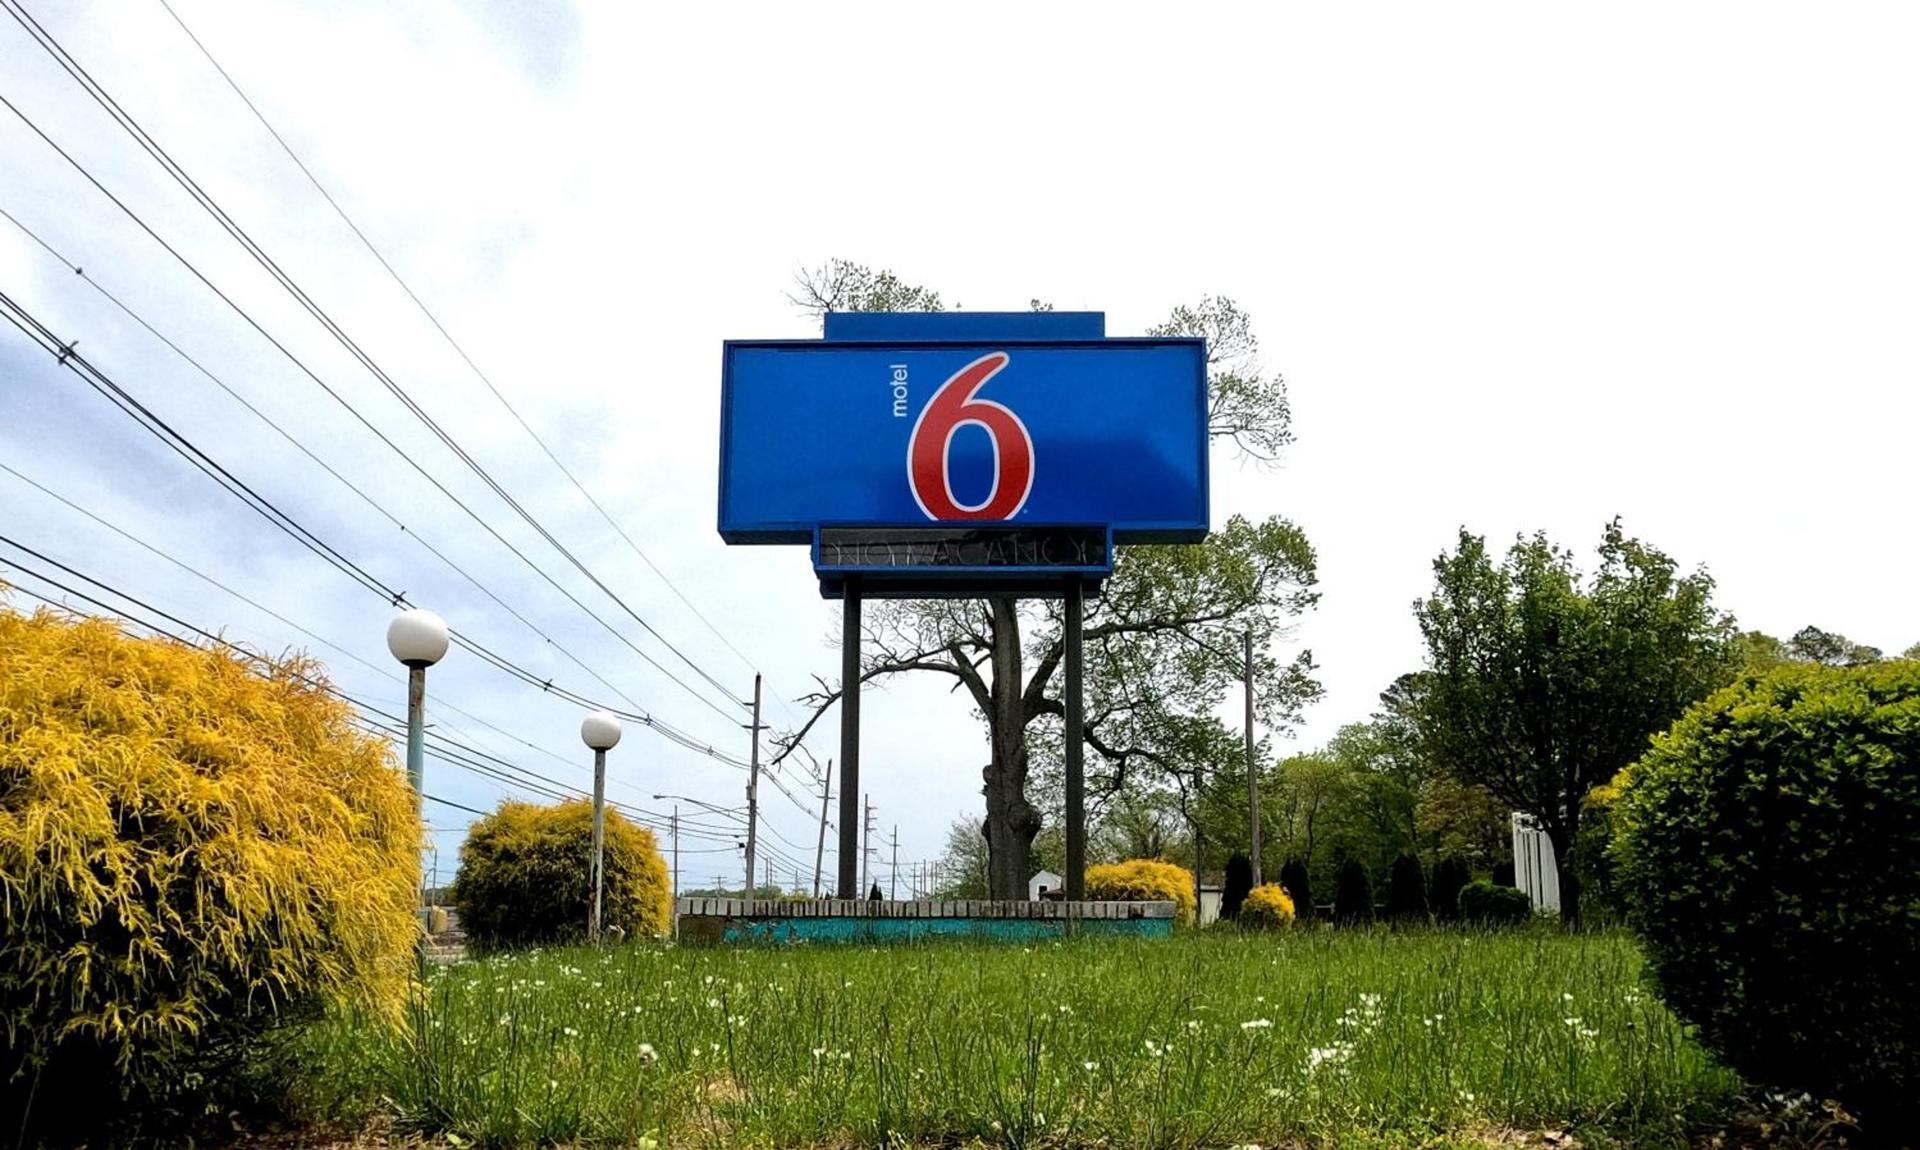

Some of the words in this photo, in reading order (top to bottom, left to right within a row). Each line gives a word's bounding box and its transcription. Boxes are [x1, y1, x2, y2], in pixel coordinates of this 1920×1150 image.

[889, 364, 908, 417] motel
[907, 352, 1035, 520] 6
[832, 540, 896, 566] NO
[906, 534, 1088, 566] VACANCY
